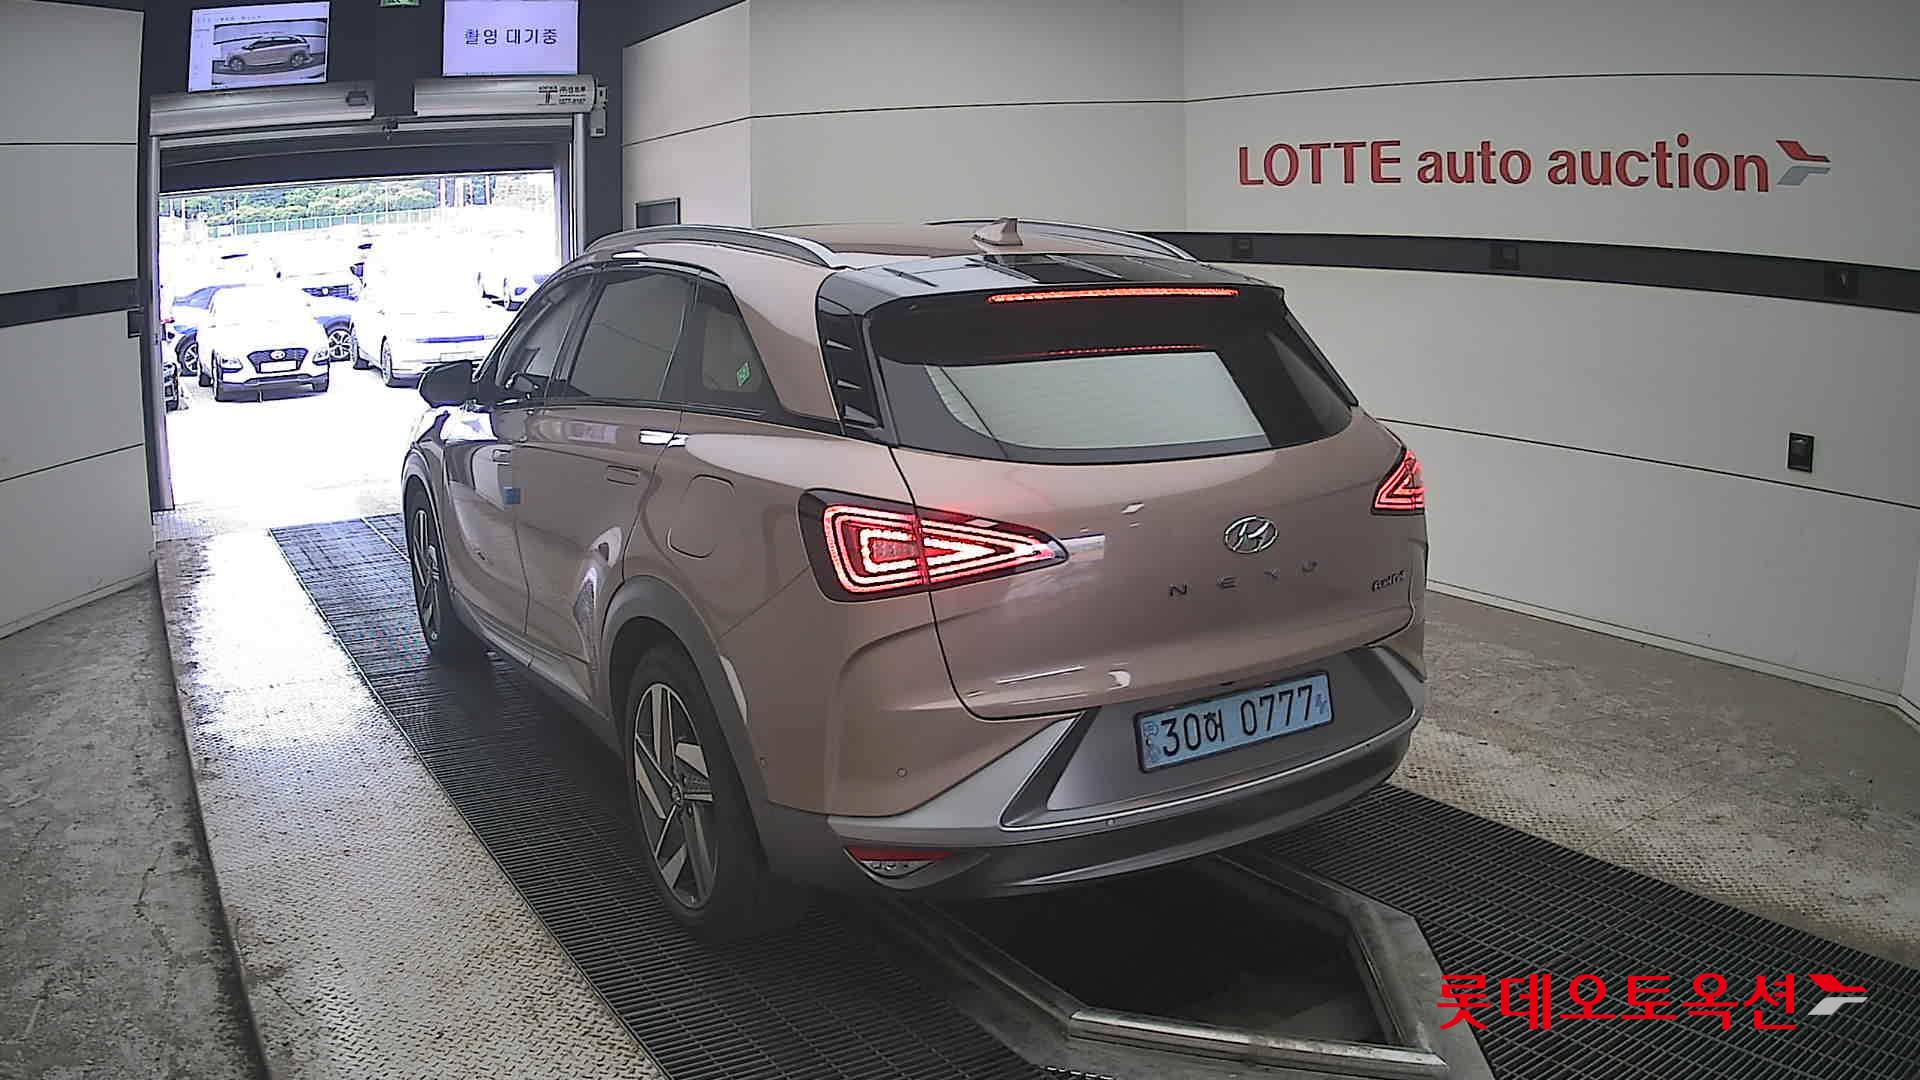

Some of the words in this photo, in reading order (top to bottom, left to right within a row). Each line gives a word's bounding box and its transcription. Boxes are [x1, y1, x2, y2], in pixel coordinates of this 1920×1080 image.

[505, 28, 557, 45] 대기중
[1239, 139, 1401, 186] LOTTE
[1416, 140, 1532, 185] auto
[1547, 133, 1769, 192] auction
[1160, 707, 1225, 757] 30허
[1239, 684, 1313, 736] 0777
